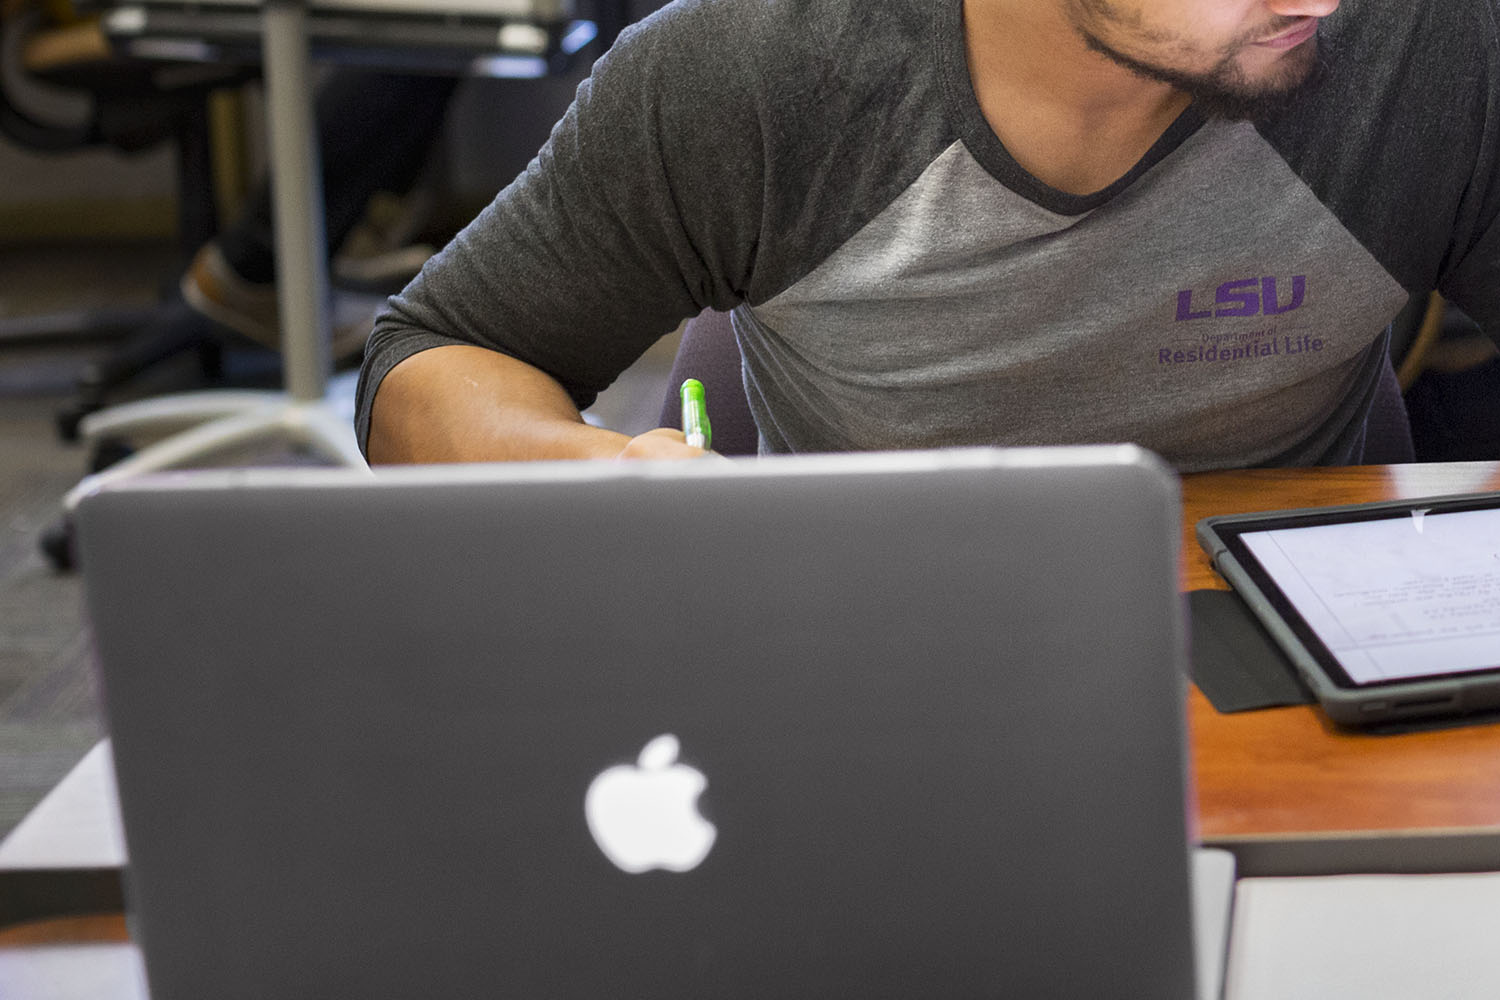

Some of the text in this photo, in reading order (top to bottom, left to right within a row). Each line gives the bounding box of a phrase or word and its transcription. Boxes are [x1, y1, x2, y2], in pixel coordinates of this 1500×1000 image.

[1175, 275, 1306, 322] LSU
[1158, 334, 1324, 364] Residential Life
